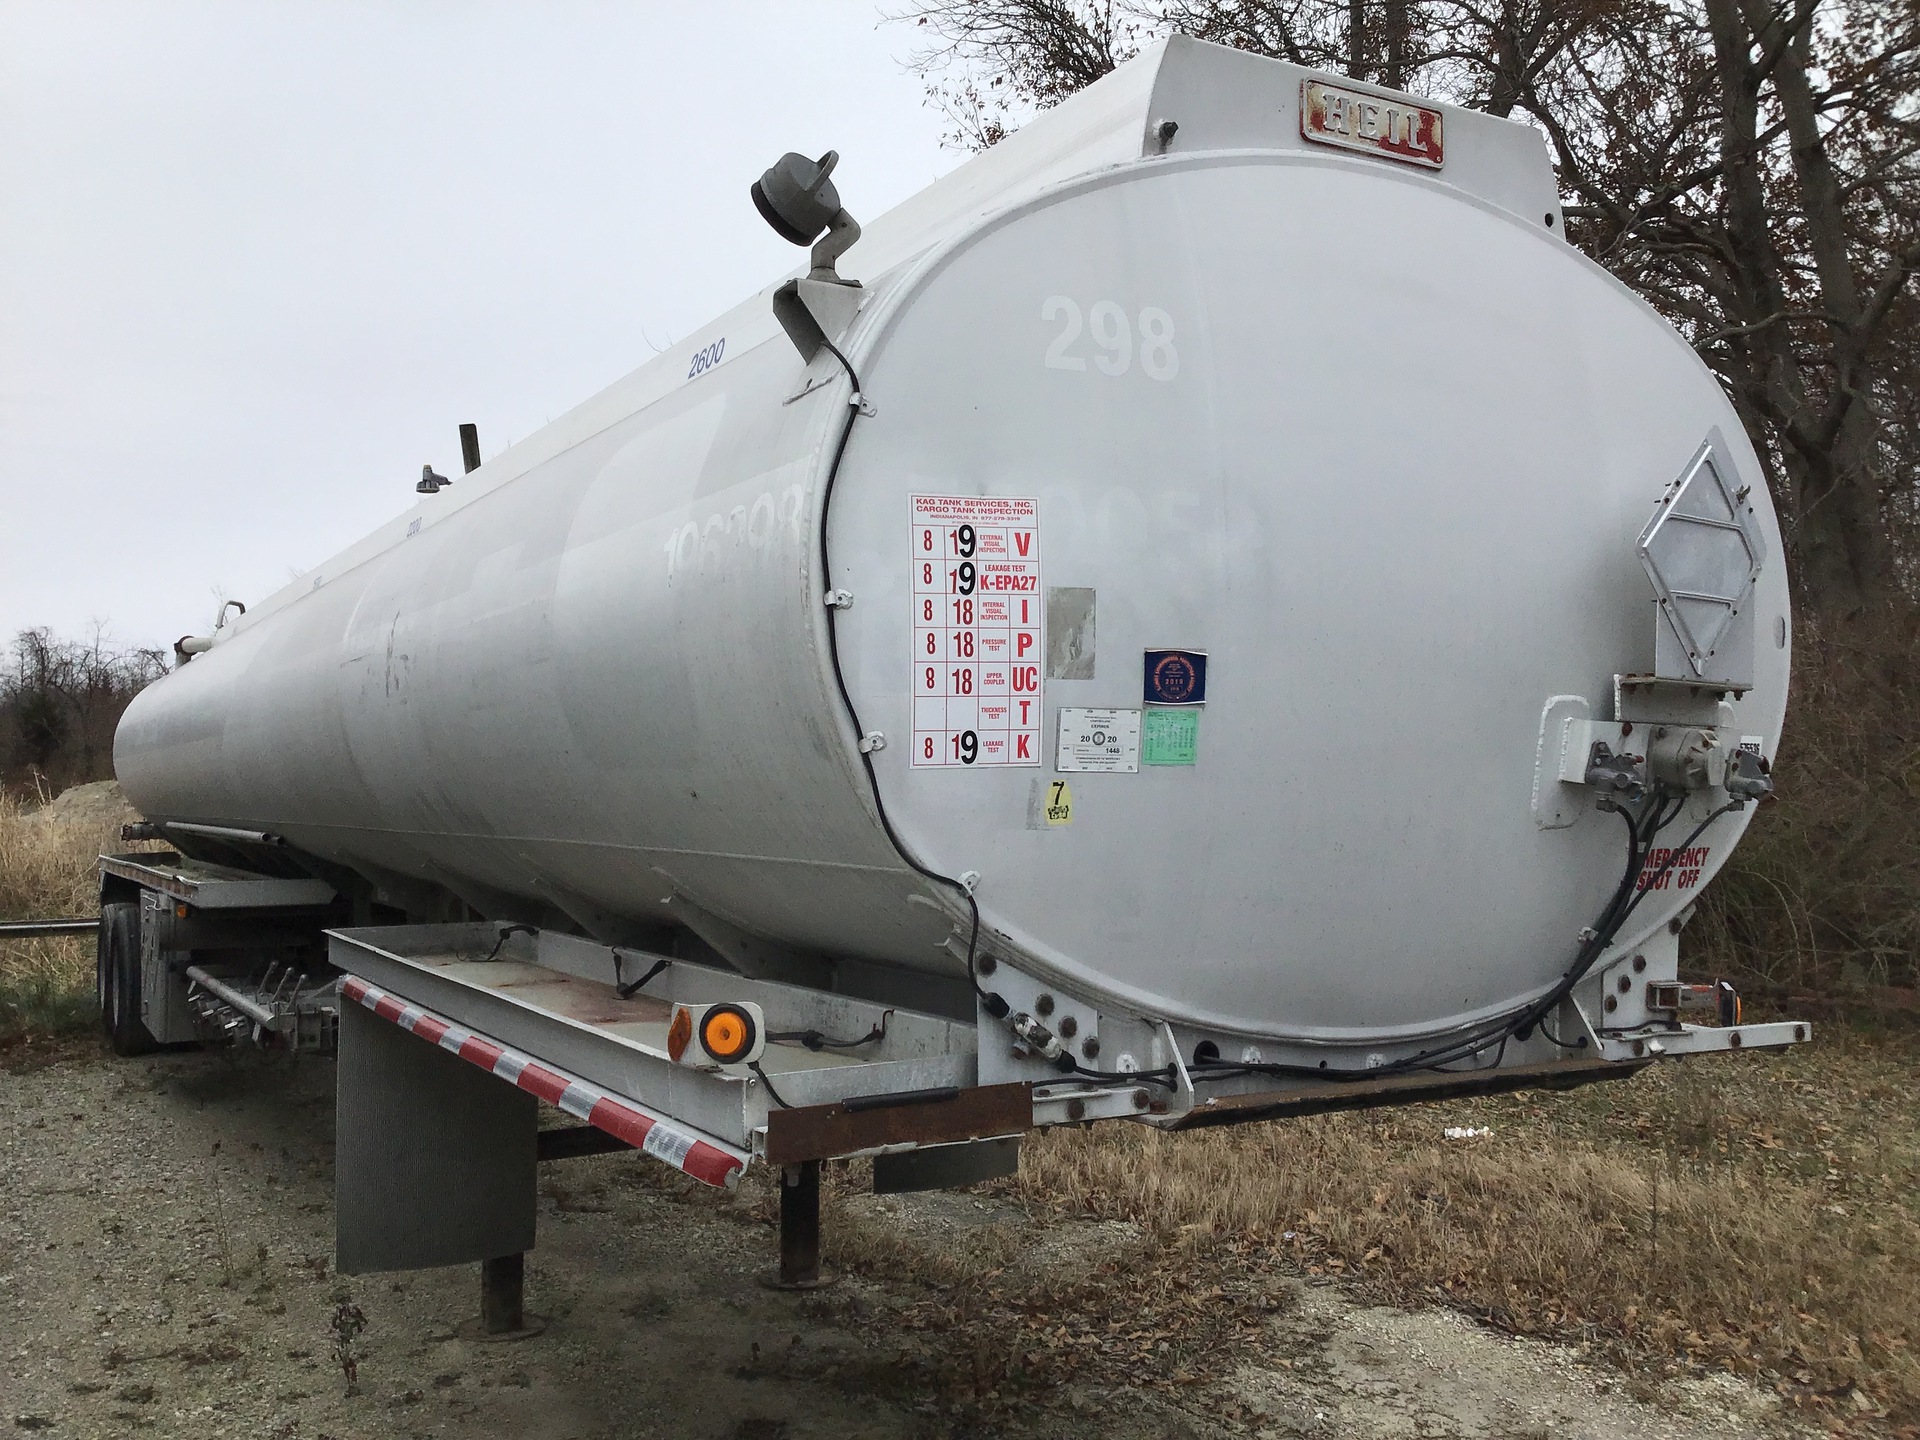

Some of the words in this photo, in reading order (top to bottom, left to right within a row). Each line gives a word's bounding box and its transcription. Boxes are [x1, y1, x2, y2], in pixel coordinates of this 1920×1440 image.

[1322, 92, 1429, 152] HEIL
[1041, 295, 1180, 382] 298
[687, 337, 726, 380] 2600
[964, 500, 1012, 508] SERVICES,
[978, 507, 1034, 515] INSPECTION
[923, 529, 933, 551] 8
[1014, 532, 1031, 557] V
[923, 563, 933, 585] 8
[984, 564, 1011, 572] LEAKAGE
[1012, 564, 1026, 572] TEST
[980, 574, 1037, 591] K-EPA27
[923, 599, 933, 621] 8
[952, 598, 973, 625] 18
[1021, 599, 1029, 624] I
[926, 632, 936, 655] 8
[953, 631, 974, 657] 18
[1017, 633, 1033, 658] P
[925, 667, 935, 689] 8
[952, 668, 972, 695] 18
[1012, 666, 1038, 692] UC
[1019, 700, 1031, 725] T
[924, 737, 934, 759] 8
[1017, 734, 1030, 759] K
[1107, 735, 1118, 743] 20
[1052, 781, 1065, 805] 7
[1645, 847, 1710, 868] MERGENCY
[1677, 869, 1701, 889] OFF
